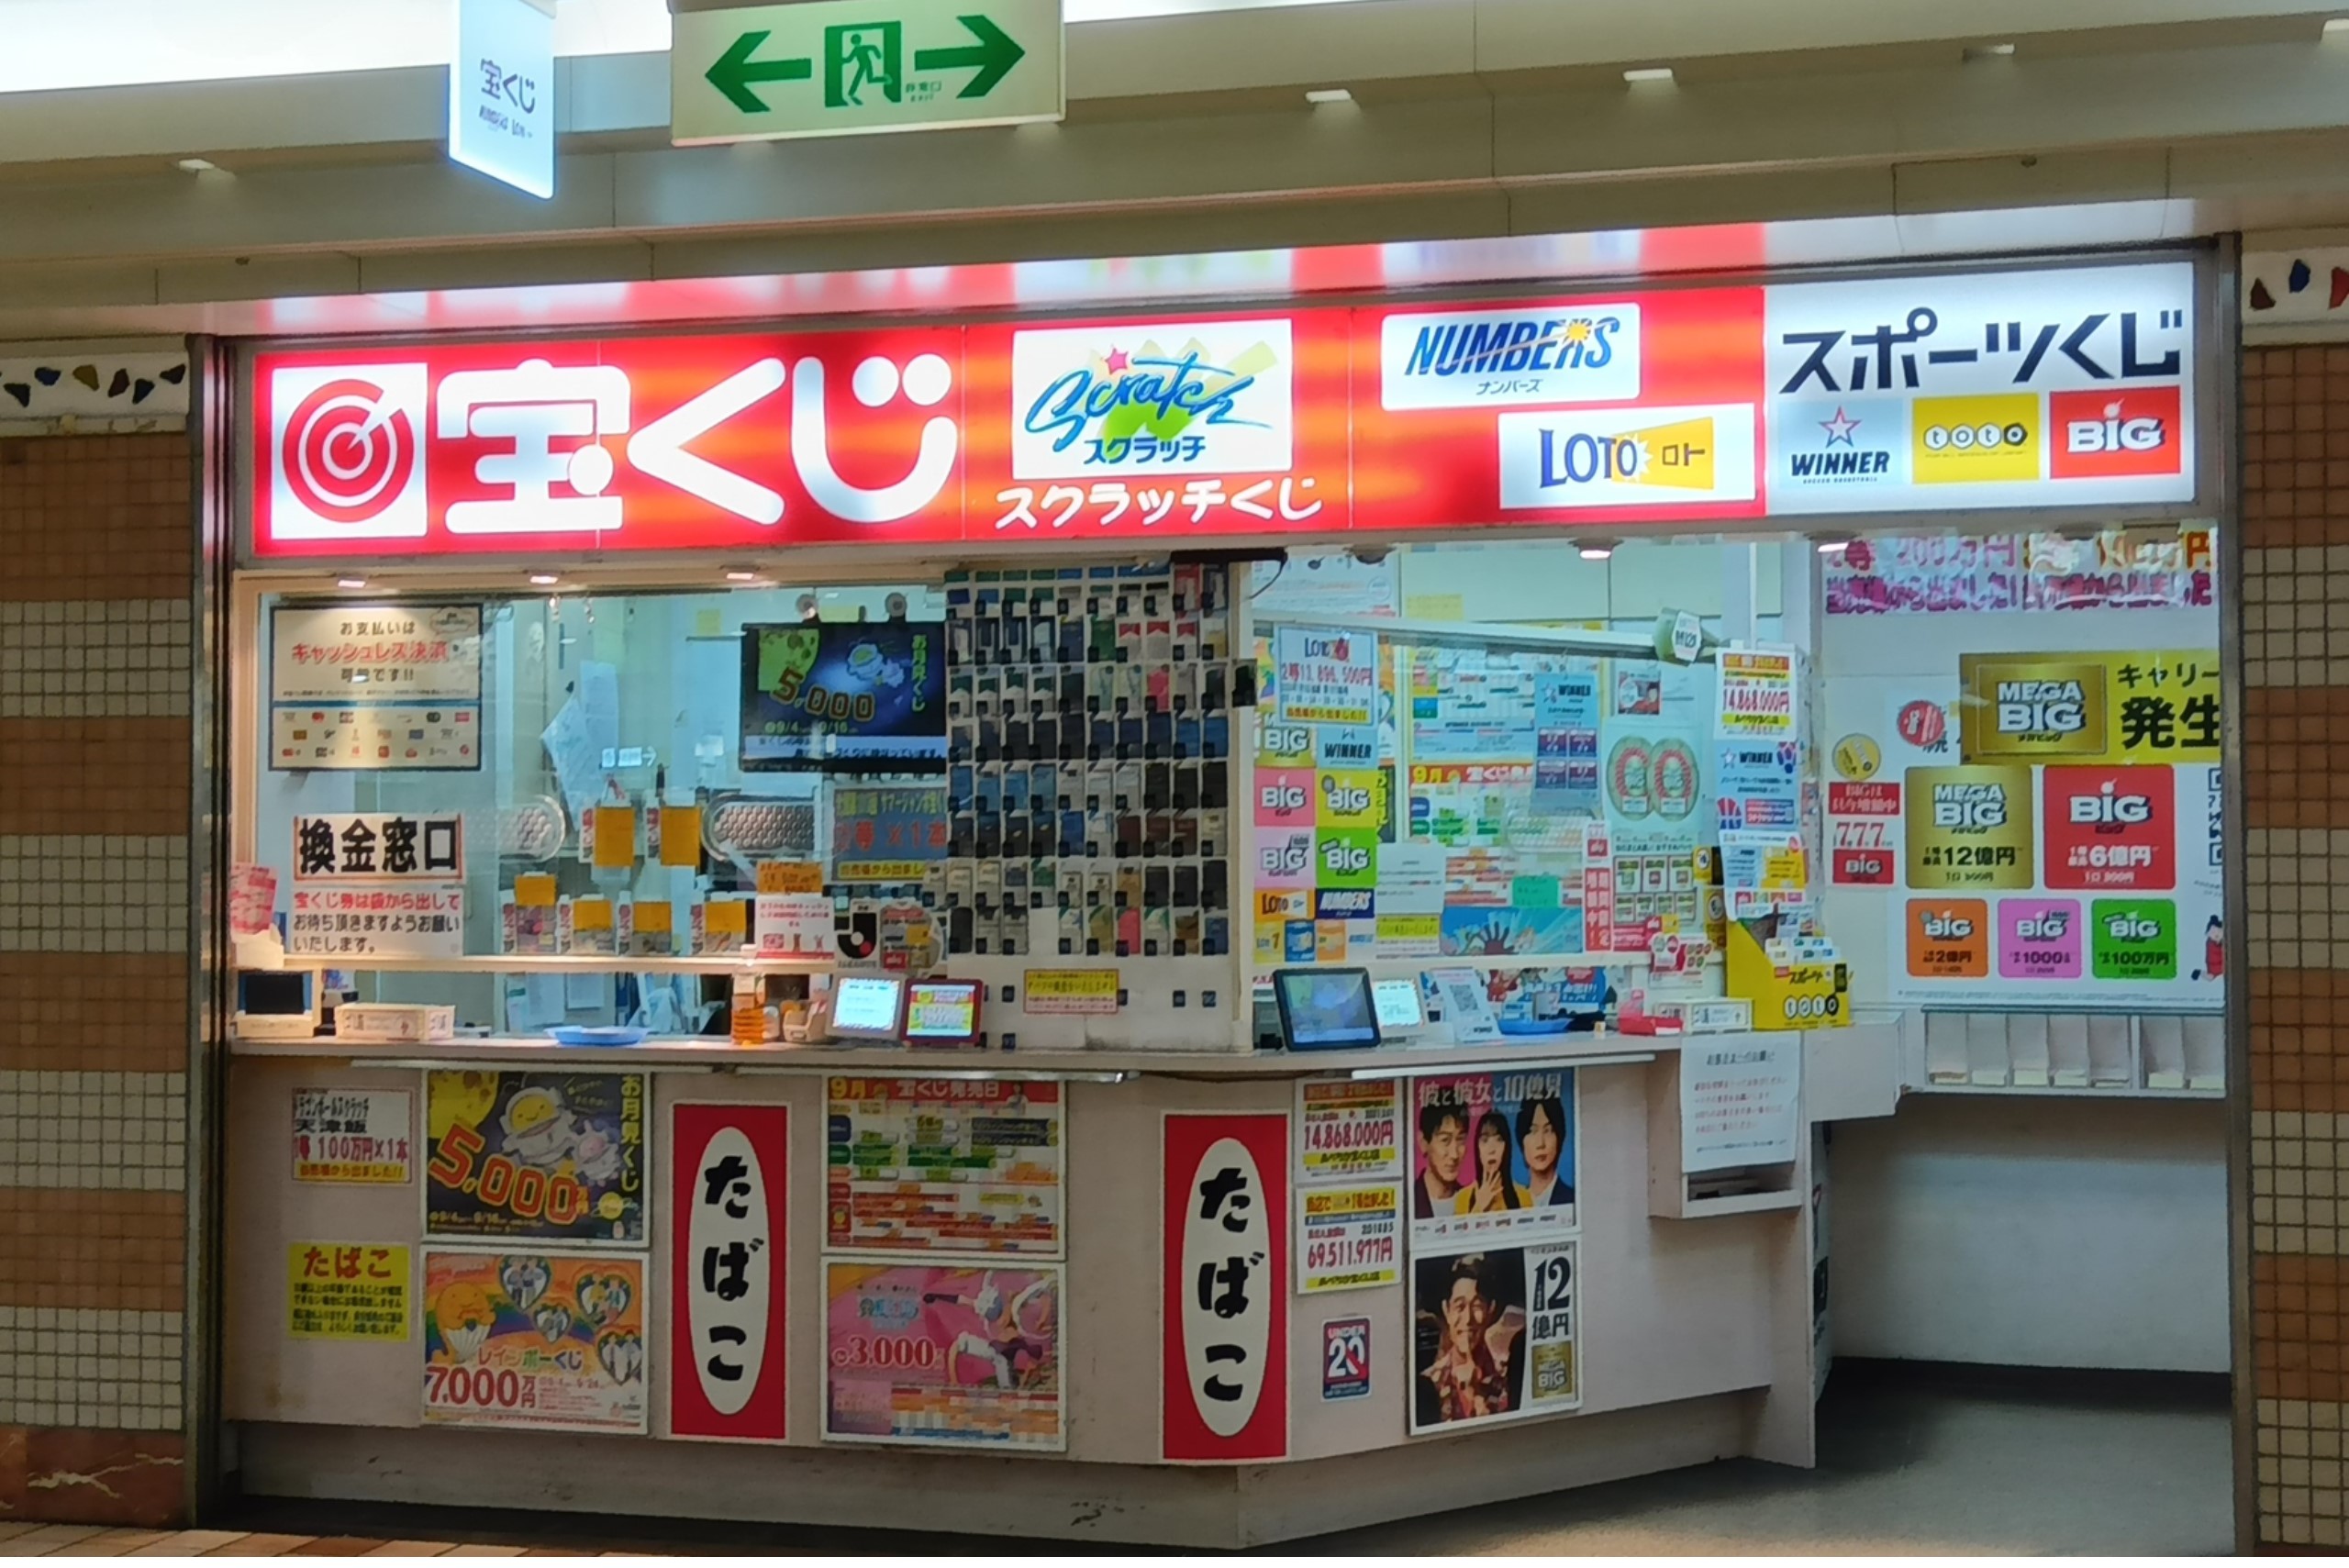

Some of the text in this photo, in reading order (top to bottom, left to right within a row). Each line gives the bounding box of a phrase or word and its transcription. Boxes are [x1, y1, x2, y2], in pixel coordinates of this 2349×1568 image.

[480, 58, 535, 114] 宝くじ
[1404, 317, 1620, 376] NUMBERS
[1779, 307, 2182, 394] スポーツくじ
[1476, 379, 1543, 395] ナンバーズ
[1923, 423, 2029, 450] toto
[2066, 400, 2165, 453] BIG
[437, 353, 958, 533] 宝くじ
[1084, 436, 1206, 464] スクラッチ
[1539, 428, 1639, 489] LOTO
[1791, 450, 1889, 477] WINNER
[995, 477, 1322, 529] スクラッチくじ
[340, 620, 417, 635] お支払いは
[292, 641, 451, 664] キャッシュレス決済
[1998, 681, 2086, 702] MEGA
[1998, 703, 2087, 732] BIG
[2121, 695, 2220, 750] 発生
[1264, 728, 1309, 751] BIG
[1324, 743, 1372, 760] WINNER
[1261, 780, 1307, 809] BIG
[1327, 780, 1371, 809] BIG
[1934, 784, 2007, 802] MEGA
[2069, 782, 2153, 824] BIG
[1934, 802, 2008, 828] BIG
[298, 817, 458, 875] 換金窓口
[1261, 842, 1308, 871] BIG
[1326, 840, 1371, 871] BIG
[1943, 845, 2016, 866] 12億円
[2089, 845, 2152, 868] 6億円
[1844, 854, 1883, 874] BIG
[294, 892, 460, 910] 宝くじ券は袋から出して
[1262, 894, 1289, 915] LOTO
[1319, 892, 1373, 911] NUMBERS
[294, 914, 460, 932] お待ち頂きますようお願い
[1925, 911, 1974, 938] BIG
[2016, 911, 2066, 938] BIG
[2110, 911, 2160, 938] BIG
[294, 936, 375, 953] いたします。
[1784, 995, 1840, 1018] toto
[620, 1075, 641, 1192] お月見くじ
[304, 1246, 392, 1278] たばこ
[702, 1155, 764, 1381] たばこ
[1197, 1167, 1264, 1402] たばこ
[1533, 1256, 1571, 1312] 12
[1532, 1313, 1570, 1340] 億円
[478, 1347, 583, 1371] レインボーくじ
[1328, 1337, 1365, 1377] 20
[521, 1375, 536, 1409] 万円
[1538, 1372, 1567, 1388] BIG
